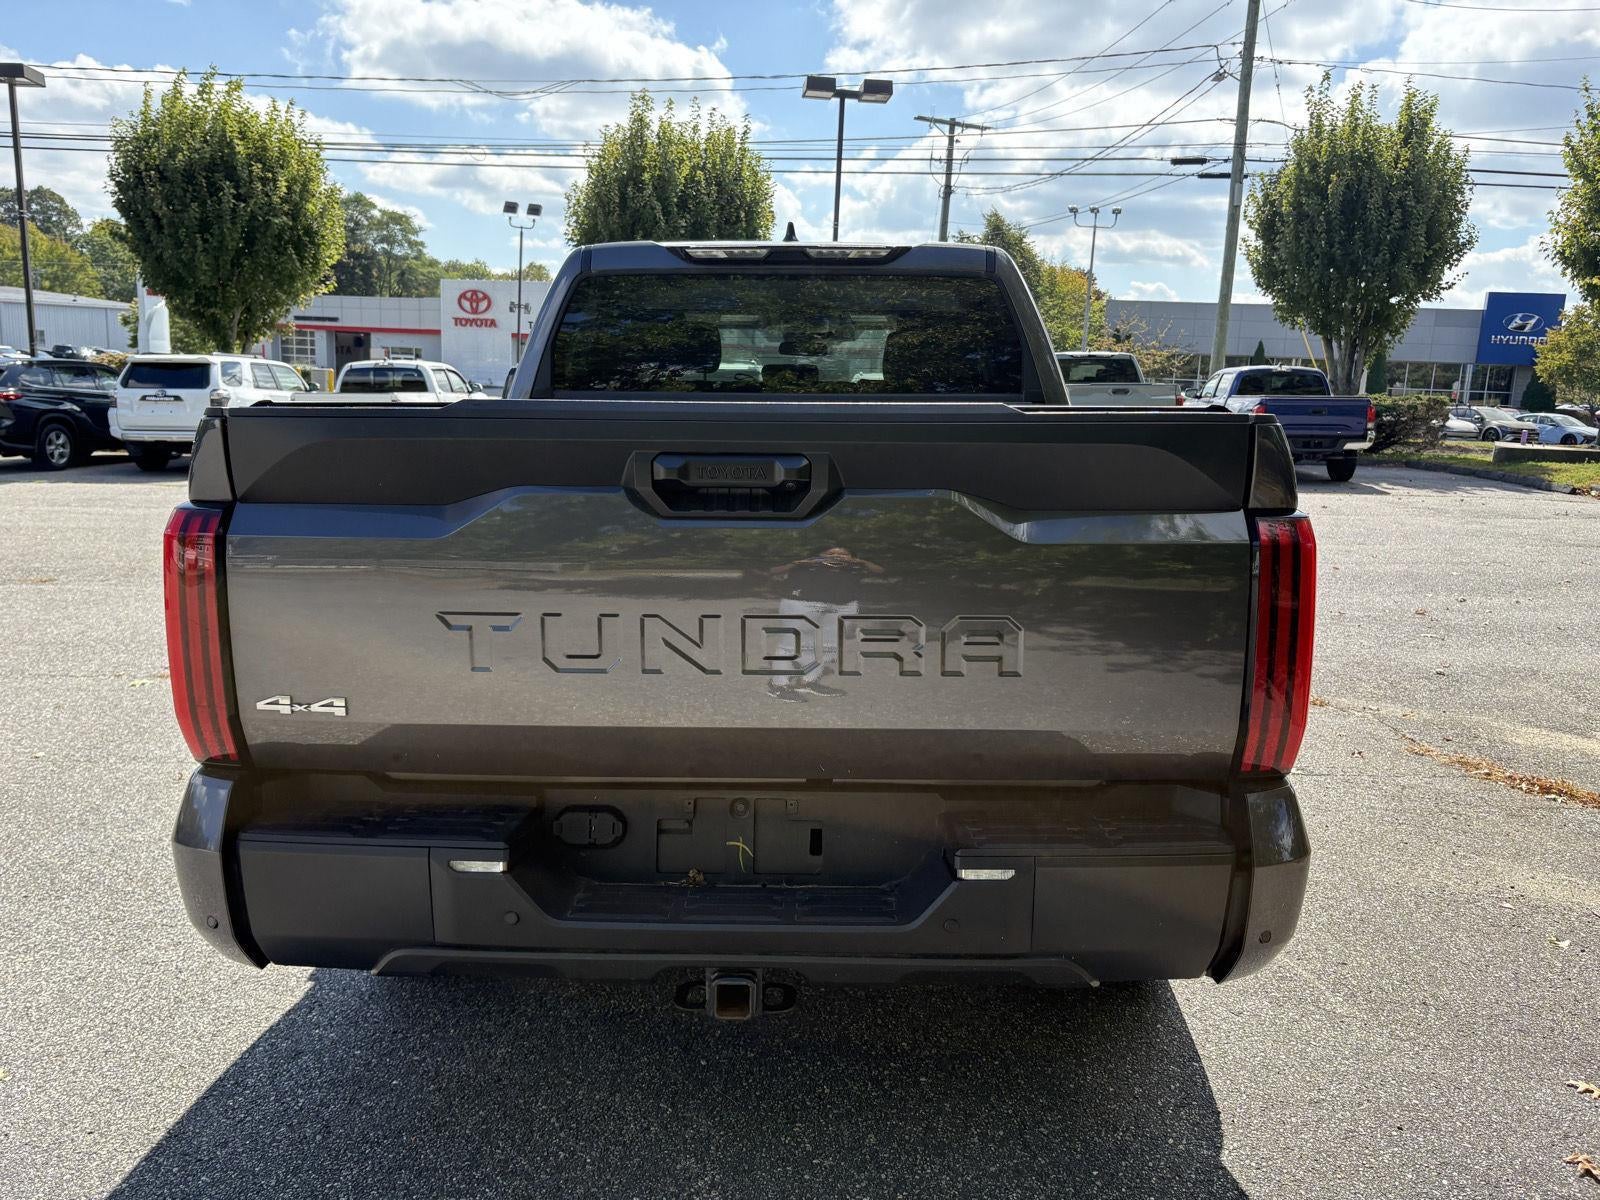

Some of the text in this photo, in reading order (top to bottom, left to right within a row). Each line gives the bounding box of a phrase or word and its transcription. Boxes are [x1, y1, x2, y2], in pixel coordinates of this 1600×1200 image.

[452, 317, 497, 328] TOYOTA
[1490, 335, 1548, 345] HYUNDA
[696, 464, 768, 480] TOYOTA
[436, 610, 1024, 677] TUNDRA
[256, 695, 347, 716] 4x4
